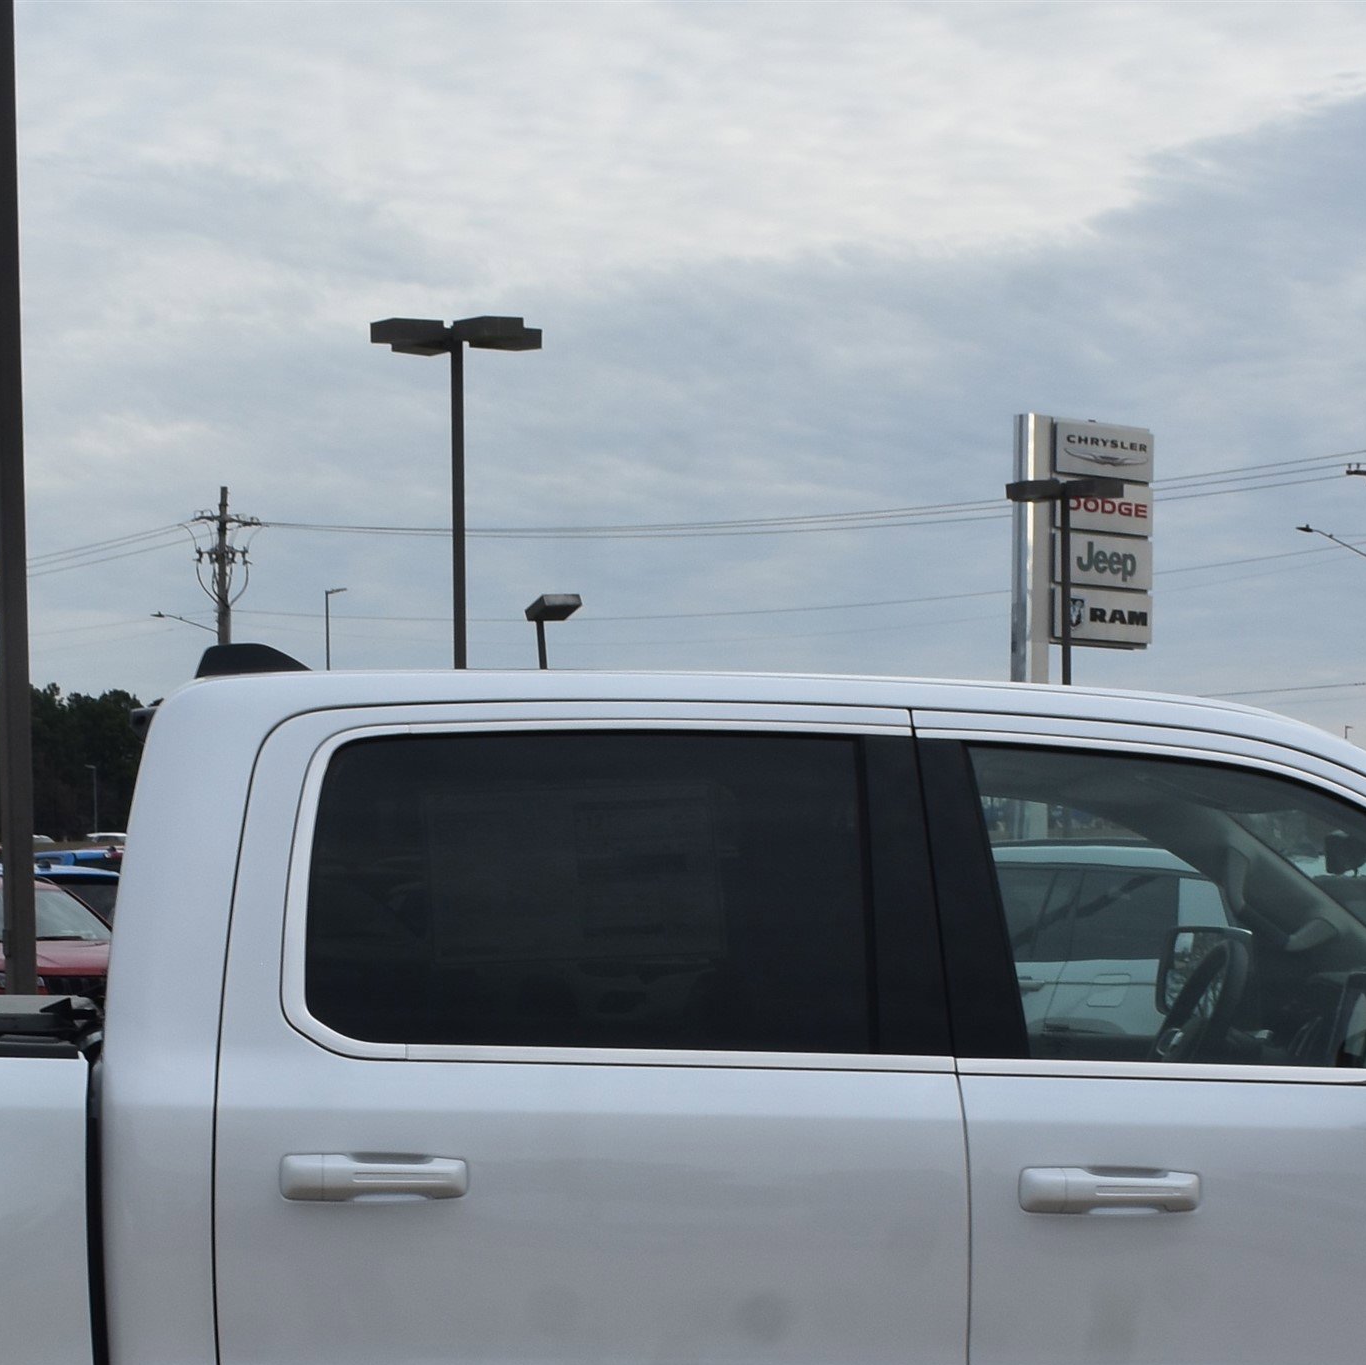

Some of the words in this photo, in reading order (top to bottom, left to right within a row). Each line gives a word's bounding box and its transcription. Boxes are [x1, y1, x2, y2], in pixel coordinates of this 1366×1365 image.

[1066, 433, 1147, 453] CHRYSLER
[1069, 495, 1148, 519] DODGE
[1076, 541, 1136, 582] Jeep
[1089, 607, 1147, 627] RAM
